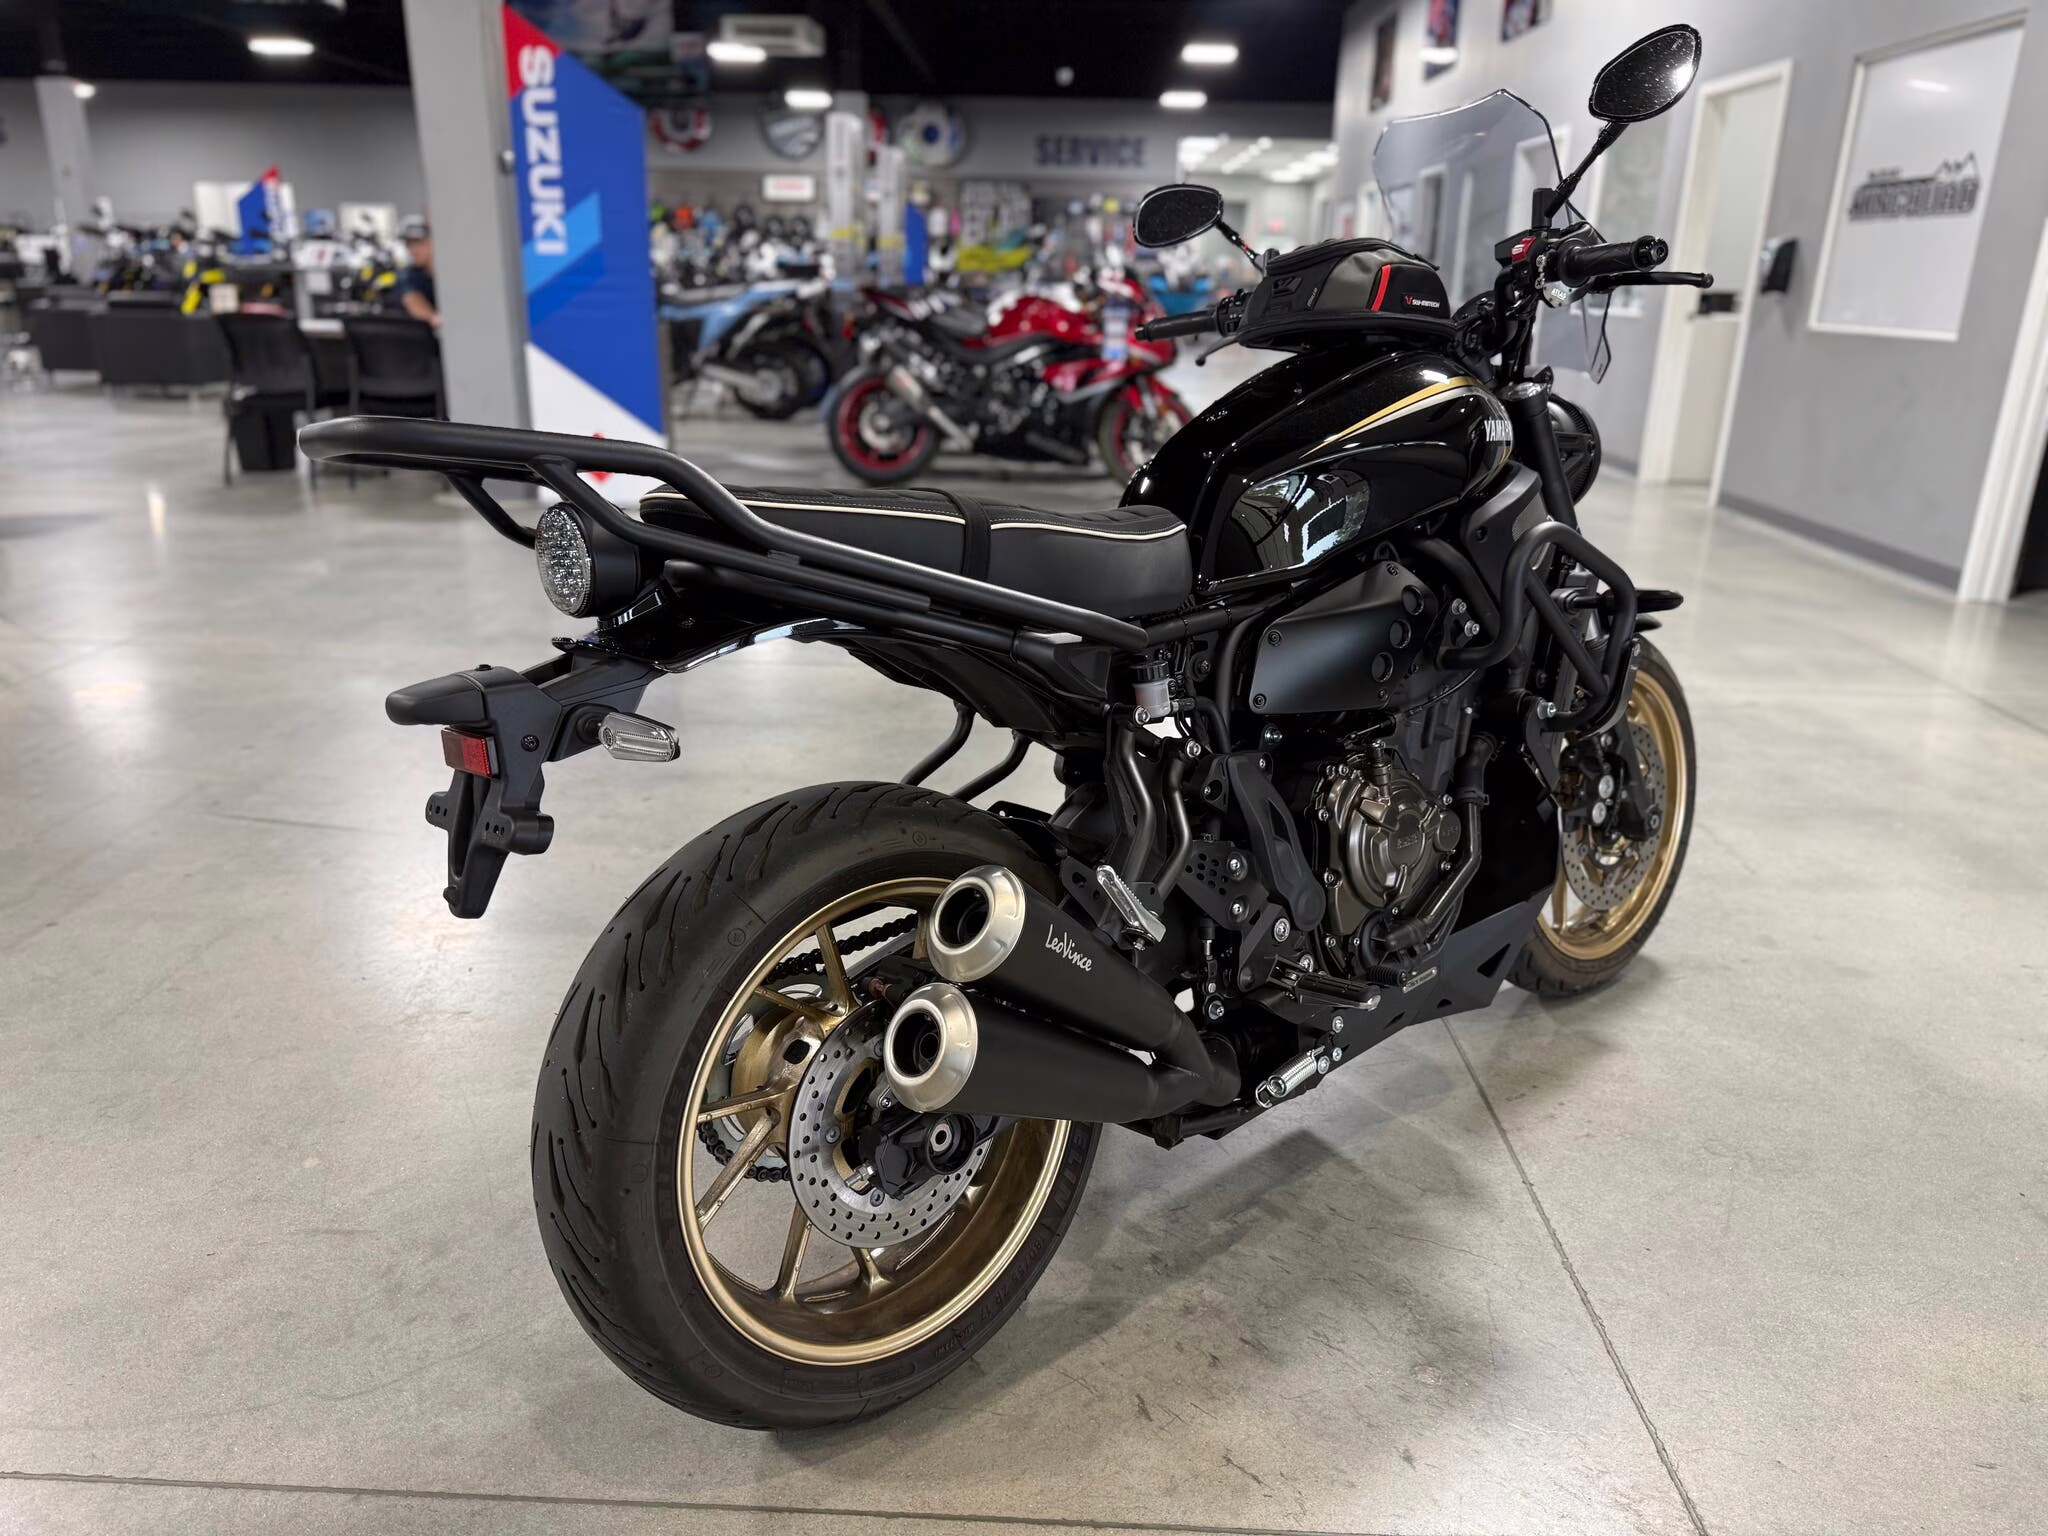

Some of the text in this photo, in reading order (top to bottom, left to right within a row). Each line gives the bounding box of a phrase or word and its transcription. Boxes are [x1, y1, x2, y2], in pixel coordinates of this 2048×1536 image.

[518, 44, 568, 256] SUZUKI
[1036, 135, 1146, 168] SERVICE
[1045, 923, 1092, 971] LeoVince
